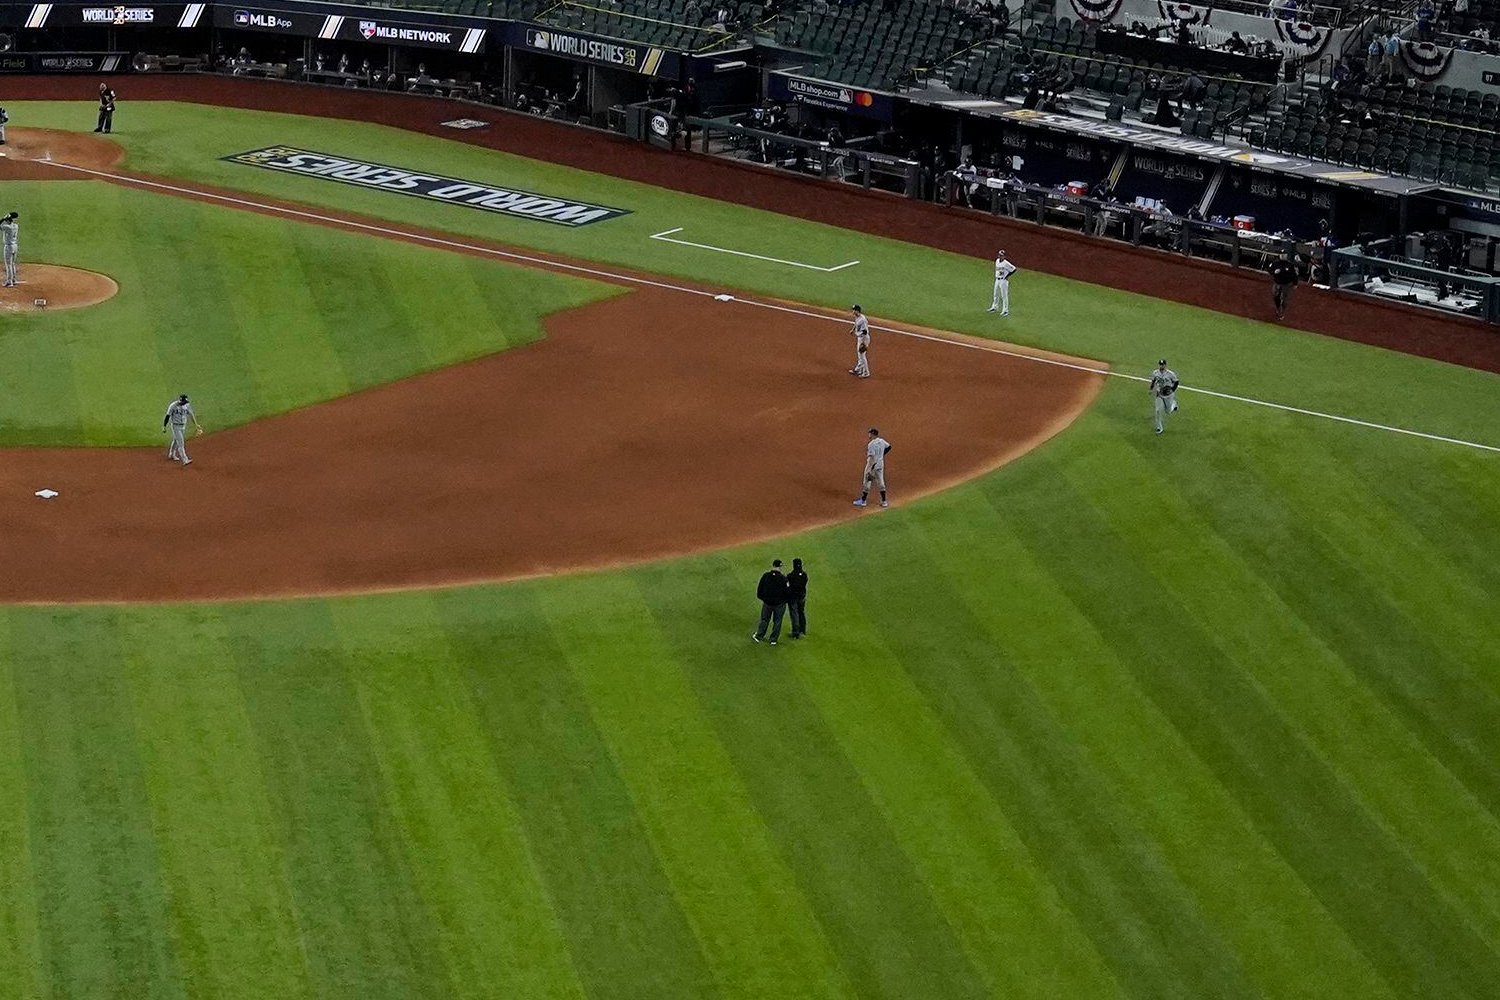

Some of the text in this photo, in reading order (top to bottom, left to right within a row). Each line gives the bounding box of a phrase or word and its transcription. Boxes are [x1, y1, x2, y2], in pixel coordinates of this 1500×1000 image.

[82, 9, 153, 21] WORLD SERIES
[250, 14, 292, 28] MLB App
[376, 27, 451, 43] MLB NETWORK
[551, 33, 624, 64] WORLD SERIES
[1134, 156, 1204, 180] WORLD SERIES
[267, 154, 611, 223] WORLD SERIES
